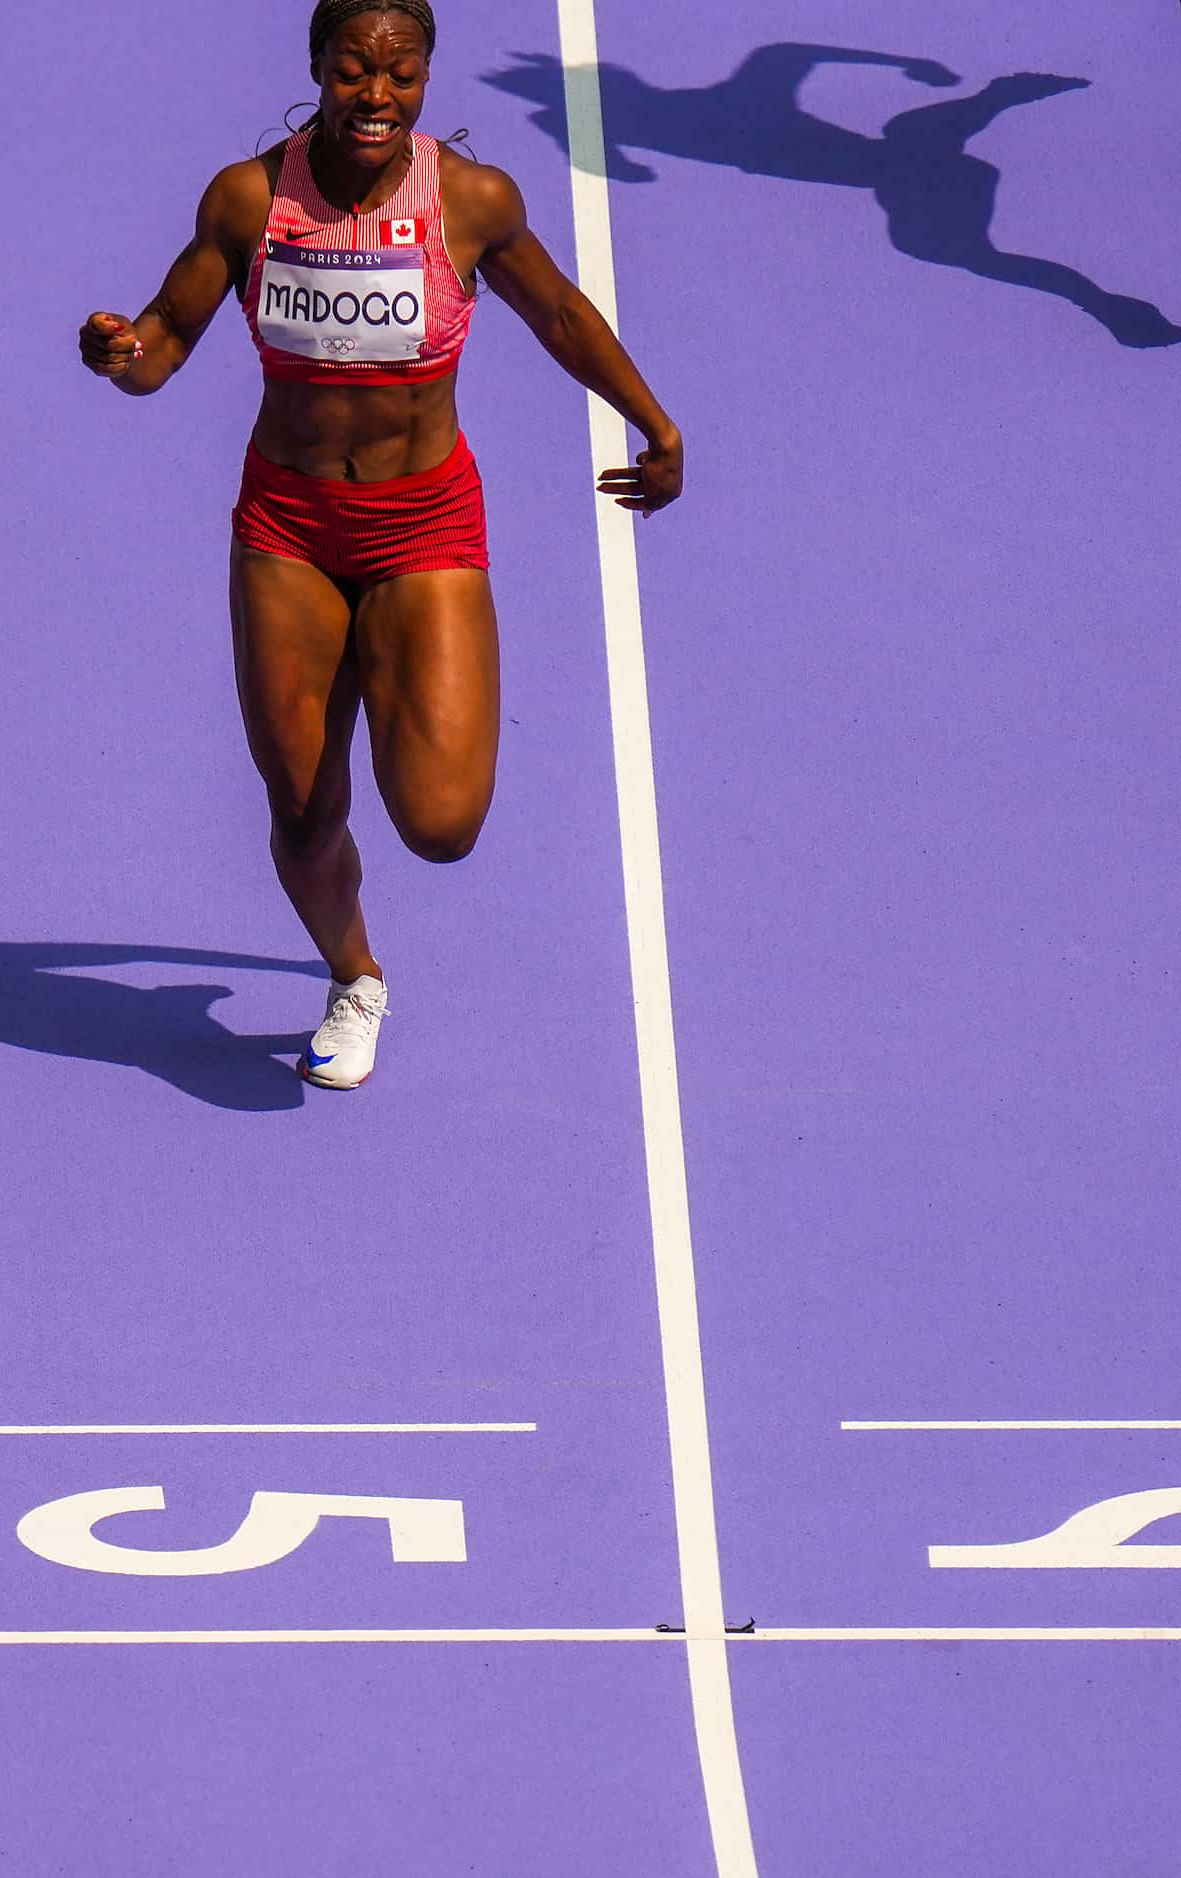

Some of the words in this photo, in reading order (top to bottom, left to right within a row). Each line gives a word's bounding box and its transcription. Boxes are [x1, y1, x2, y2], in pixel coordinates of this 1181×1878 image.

[300, 251, 340, 265] PARIS
[344, 253, 382, 265] 2024
[265, 281, 420, 326] MADOGO
[16, 1485, 468, 1577] 5
